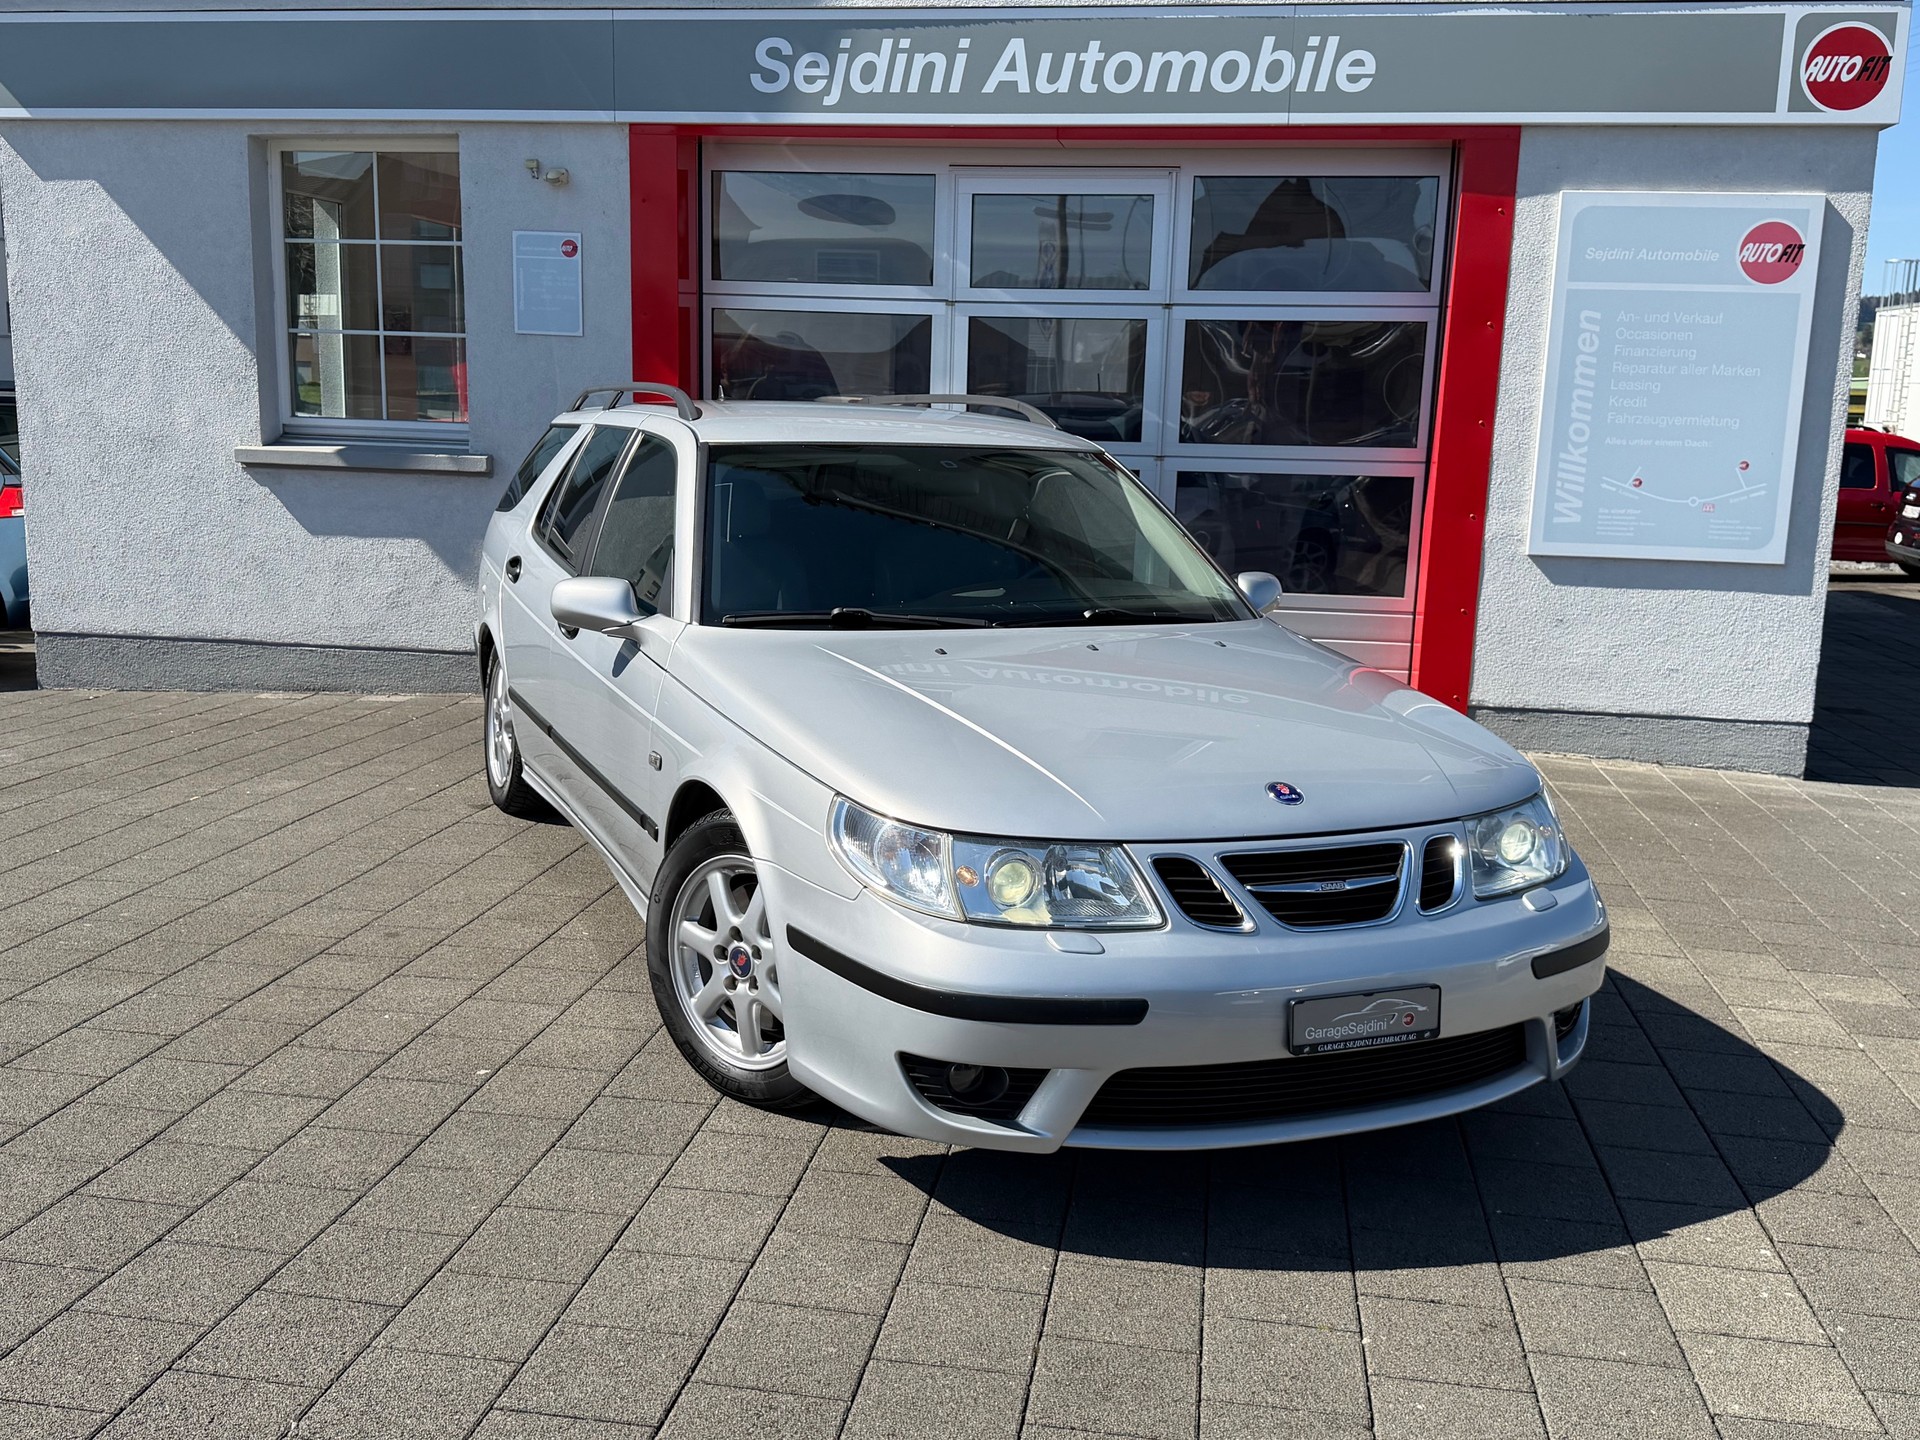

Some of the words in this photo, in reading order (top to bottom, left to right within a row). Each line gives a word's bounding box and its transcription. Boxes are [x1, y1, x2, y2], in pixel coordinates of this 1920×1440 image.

[749, 37, 970, 106] Sejdini
[981, 36, 1376, 94] Automobile
[1804, 55, 1893, 83] AUTOFIT
[1585, 247, 1635, 262] Sejdini
[1637, 249, 1720, 262] Automobile
[1738, 243, 1806, 263] AUTOFIT
[1616, 311, 1641, 324] An-
[1644, 312, 1669, 324] und
[1673, 312, 1724, 325] Verkauf
[1615, 327, 1694, 342] Occasionen
[1614, 345, 1698, 361] Finanzierung
[1612, 362, 1677, 378] Reparatur
[1680, 363, 1707, 376] aller
[1711, 364, 1761, 377] Marken
[1610, 379, 1661, 394] Leasing
[1609, 396, 1648, 408] Kredit
[1552, 309, 1602, 524] Willkommen
[1606, 412, 1740, 430] Fahrzeugvermietung
[1605, 437, 1627, 446] Alles
[1629, 439, 1653, 447] unter
[1655, 440, 1682, 448] einem
[1321, 882, 1345, 891] SAAB
[1305, 1019, 1387, 1040] GarageSejdini
[1317, 1041, 1345, 1052] GARAGE
[1345, 1038, 1372, 1050] SEJDINI
[1372, 1034, 1407, 1046] LEIMBACH
[1406, 1032, 1417, 1041] AG
